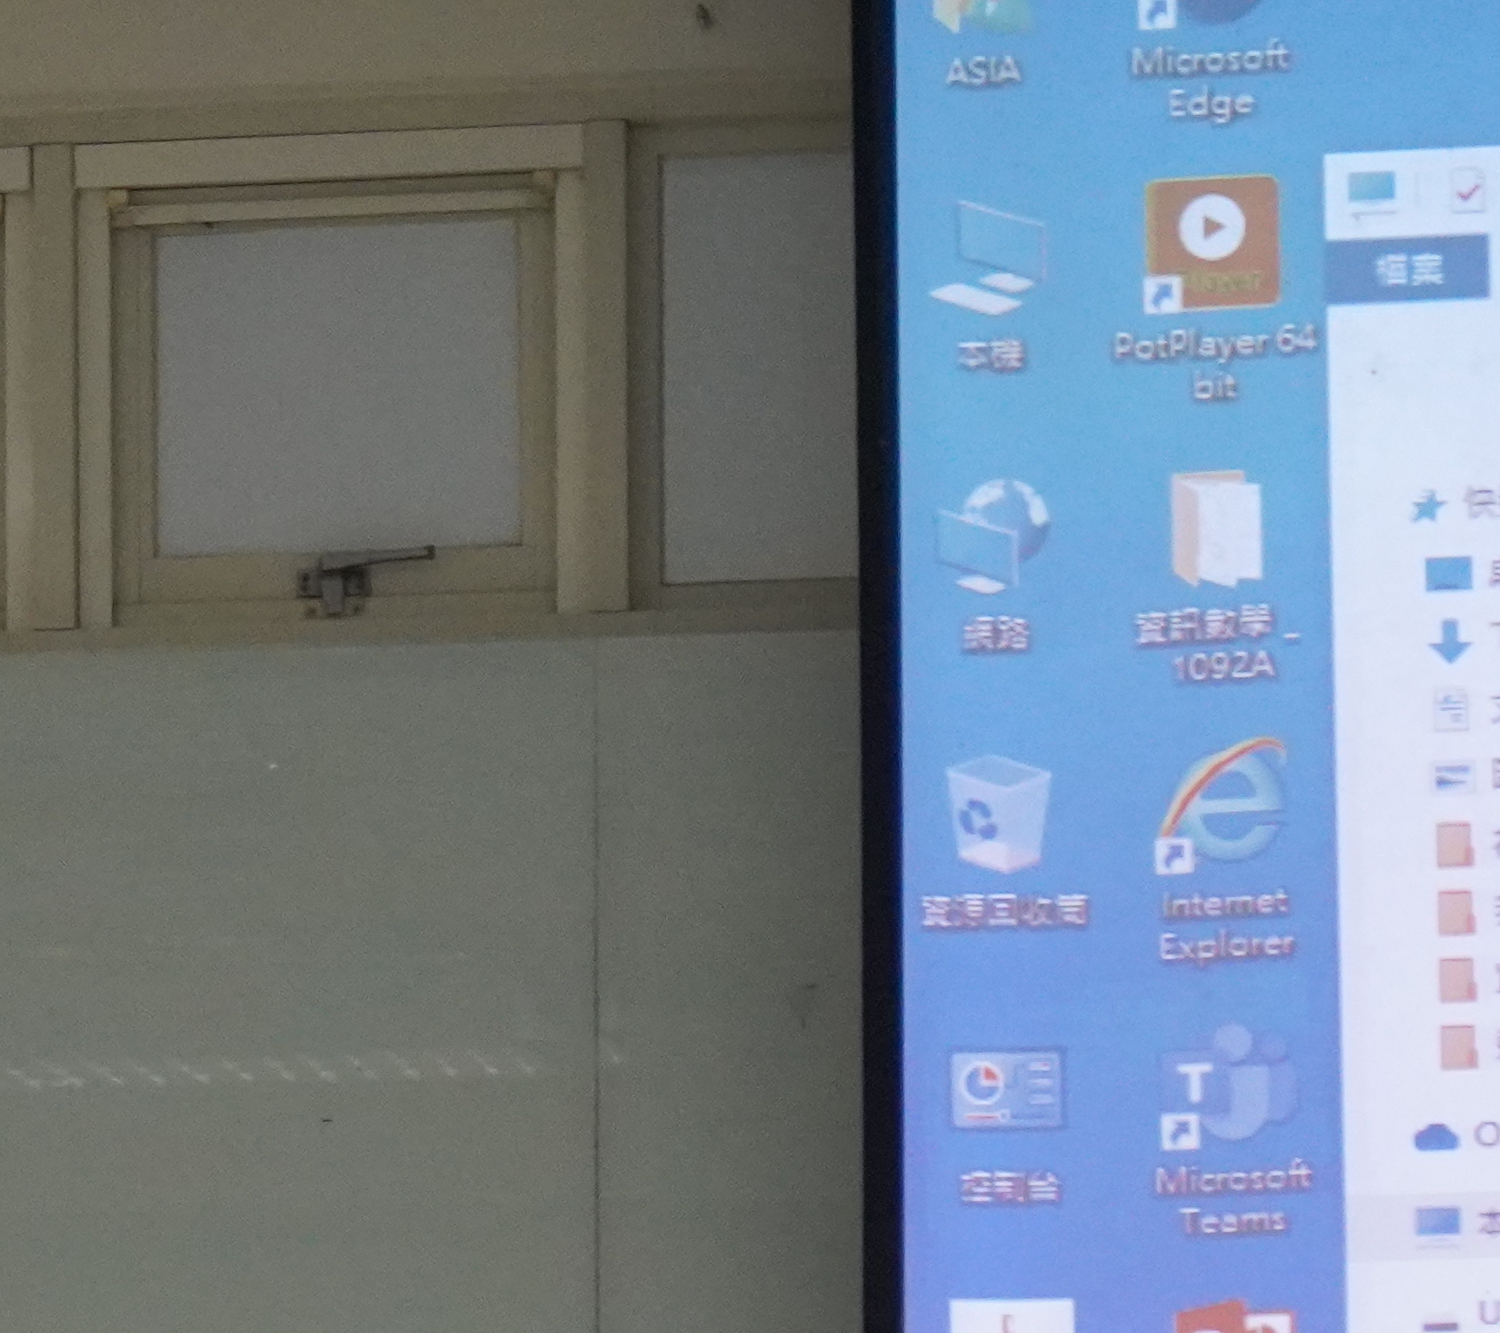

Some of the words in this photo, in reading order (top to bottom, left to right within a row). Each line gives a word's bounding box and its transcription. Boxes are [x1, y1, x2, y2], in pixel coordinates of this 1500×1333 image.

[945, 56, 1022, 86] ASIA
[1131, 38, 1290, 76] Microsoft
[1170, 87, 1256, 122] Edge
[1113, 327, 1270, 365] PotPlayer
[1276, 324, 1318, 354] 64
[1194, 373, 1236, 400] bit
[1173, 650, 1276, 683] 1092A
[1163, 889, 1290, 918] Internet
[1160, 930, 1295, 966] Explorer
[1155, 1158, 1313, 1196] Microsoft
[1179, 1206, 1287, 1236] Teams
